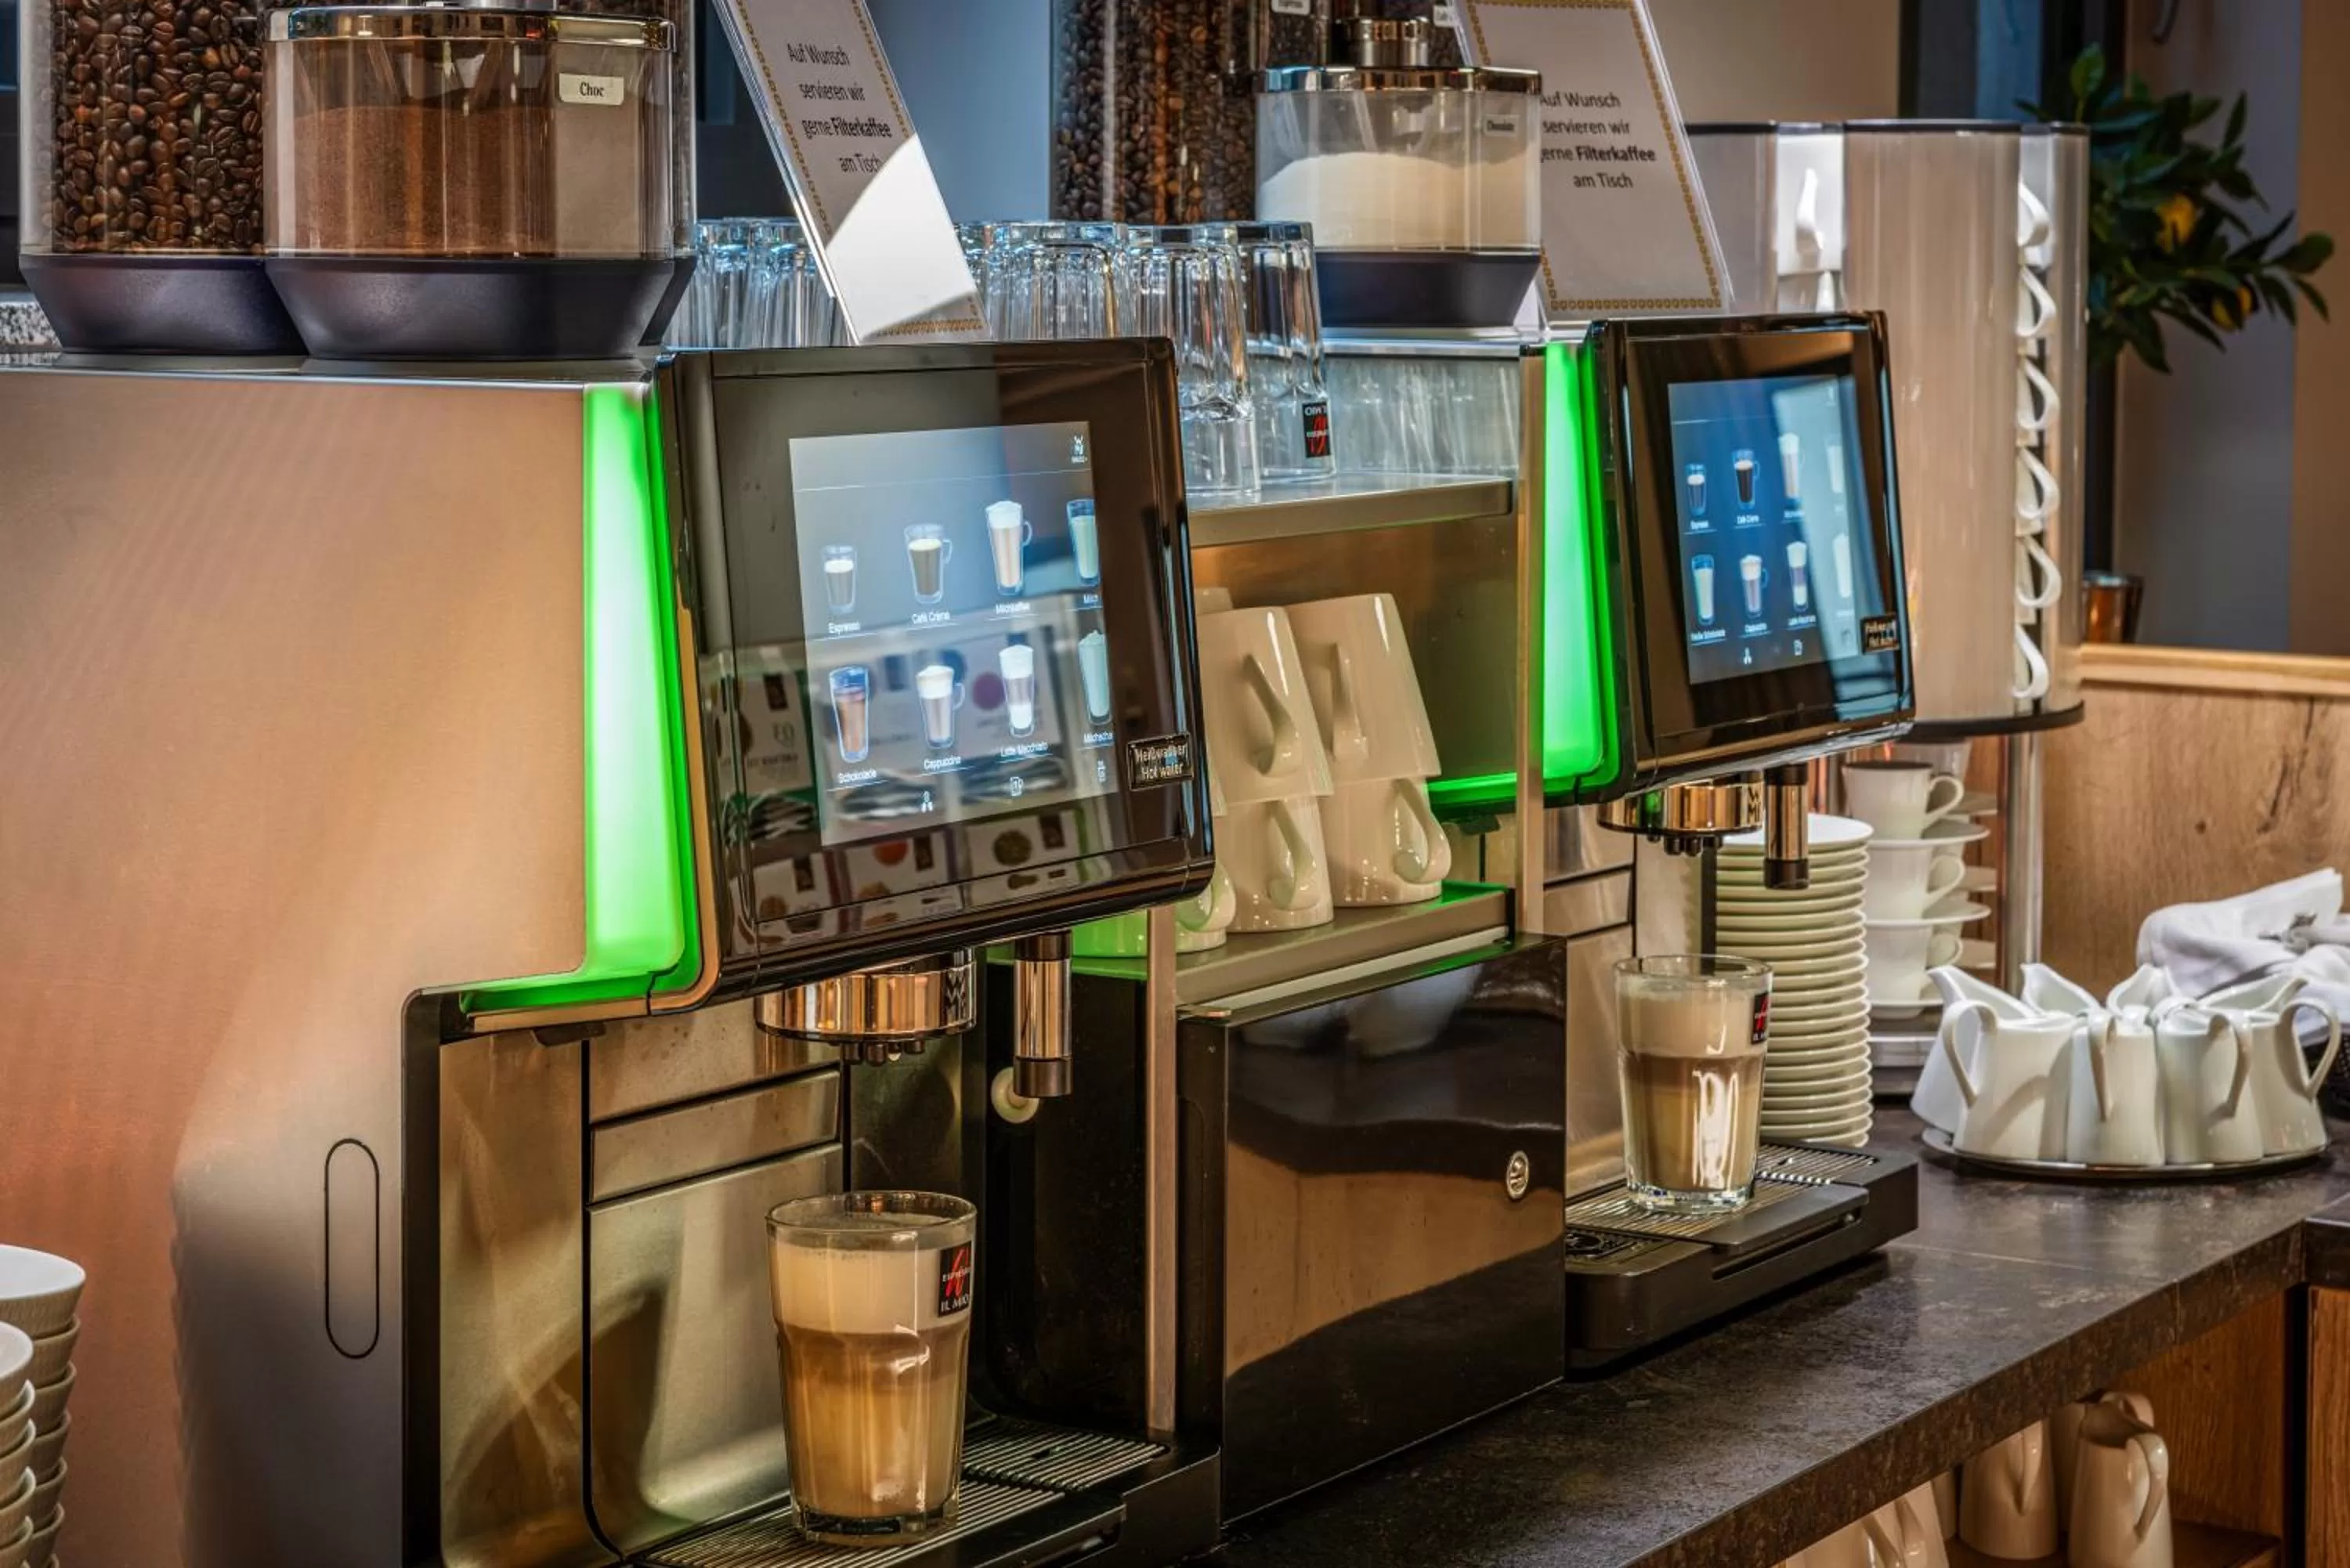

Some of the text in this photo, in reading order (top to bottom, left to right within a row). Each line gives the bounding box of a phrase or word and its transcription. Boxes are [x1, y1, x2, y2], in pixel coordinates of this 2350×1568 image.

[787, 43, 850, 66] Auf Wunsch
[799, 80, 865, 100] servieren wir
[1565, 92, 1622, 107] Wunsch
[802, 117, 892, 139] gerne Filterkaffee
[1542, 119, 1629, 134] servieren wir
[1575, 145, 1656, 161] Filterkaffee
[839, 153, 885, 173] am Tisch
[1573, 172, 1633, 188] am Tisch
